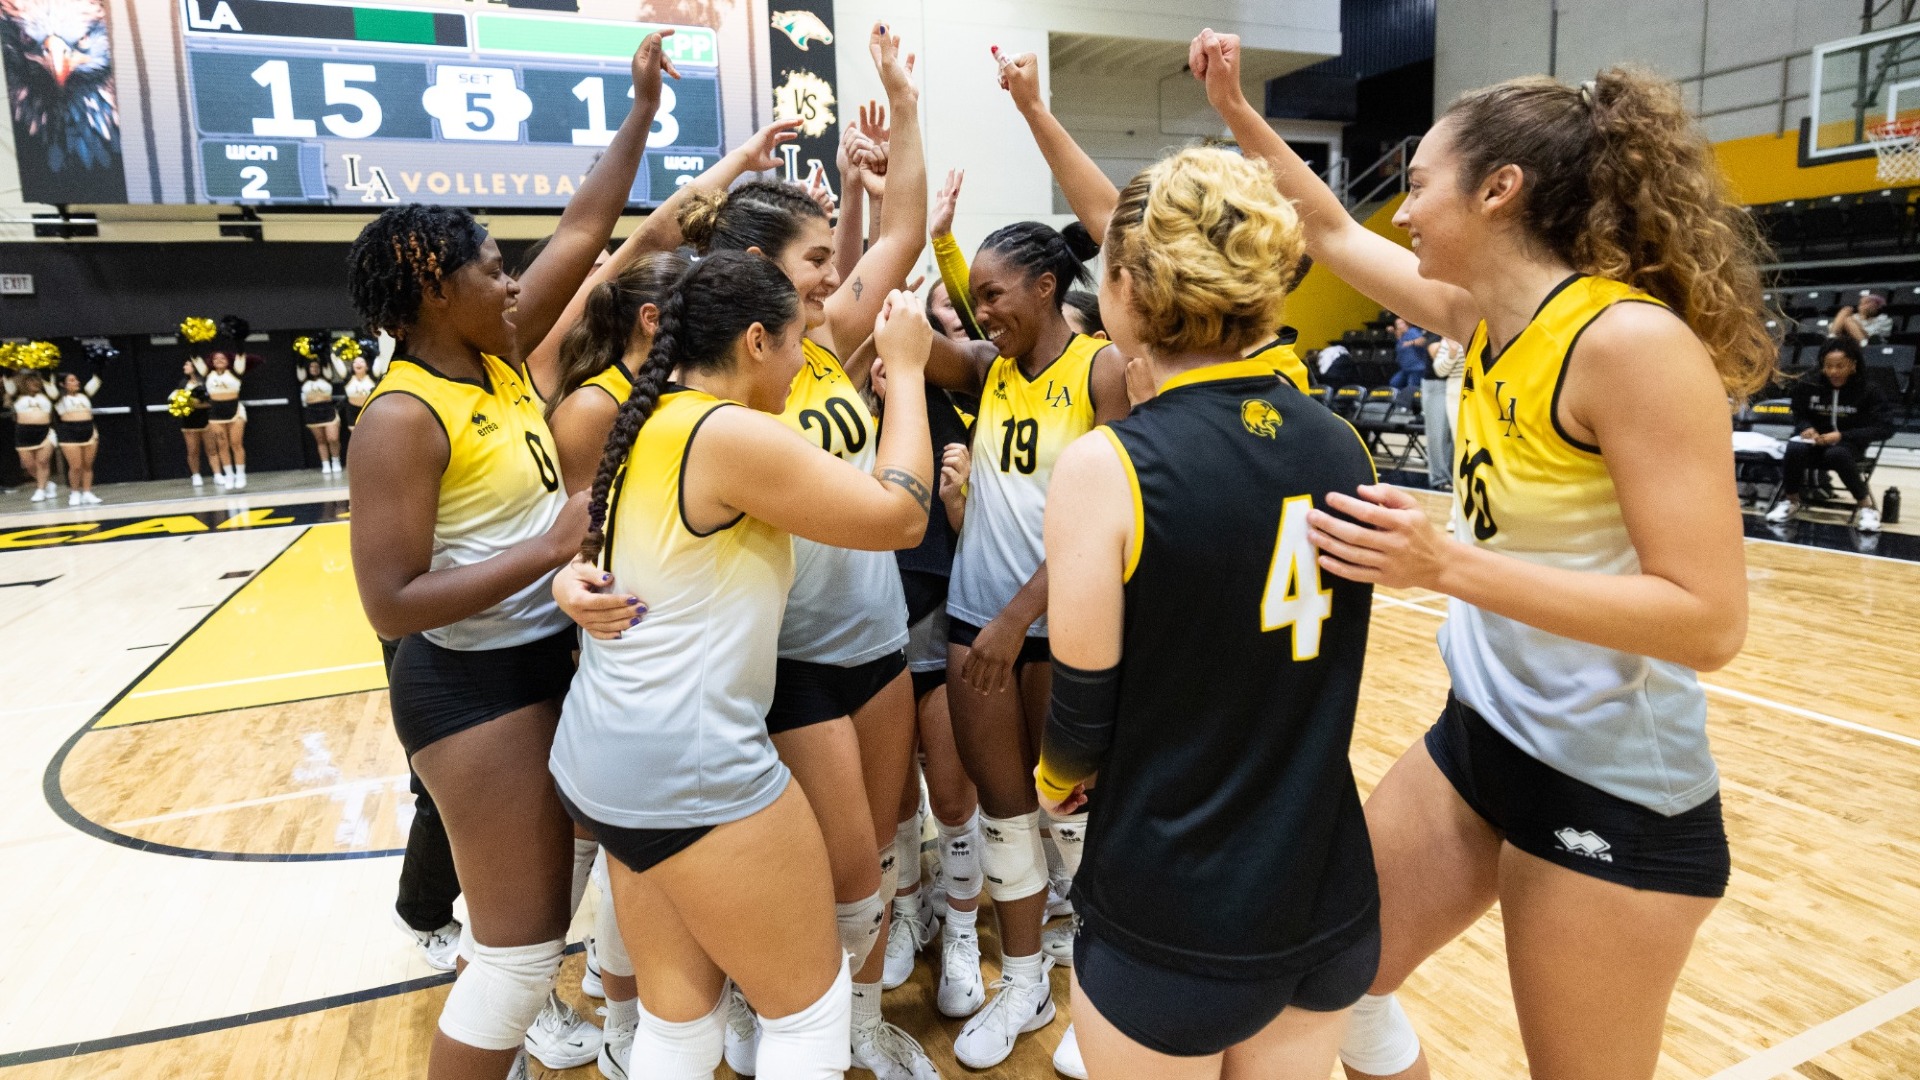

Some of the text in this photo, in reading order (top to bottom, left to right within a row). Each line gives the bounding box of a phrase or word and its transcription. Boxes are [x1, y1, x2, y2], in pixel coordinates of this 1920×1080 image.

[190, 0, 243, 31] LA
[664, 33, 711, 59] PP
[458, 73, 494, 85] SET
[251, 60, 383, 138] 15
[465, 92, 495, 131] 5
[794, 88, 817, 120] VS
[239, 166, 270, 199] 2
[343, 154, 586, 202] LA VOLLEYBA
[1045, 380, 1073, 407] LA
[477, 421, 499, 437] errea
[799, 397, 866, 458] 20
[1002, 415, 1038, 475] 19
[1260, 494, 1332, 662] 4
